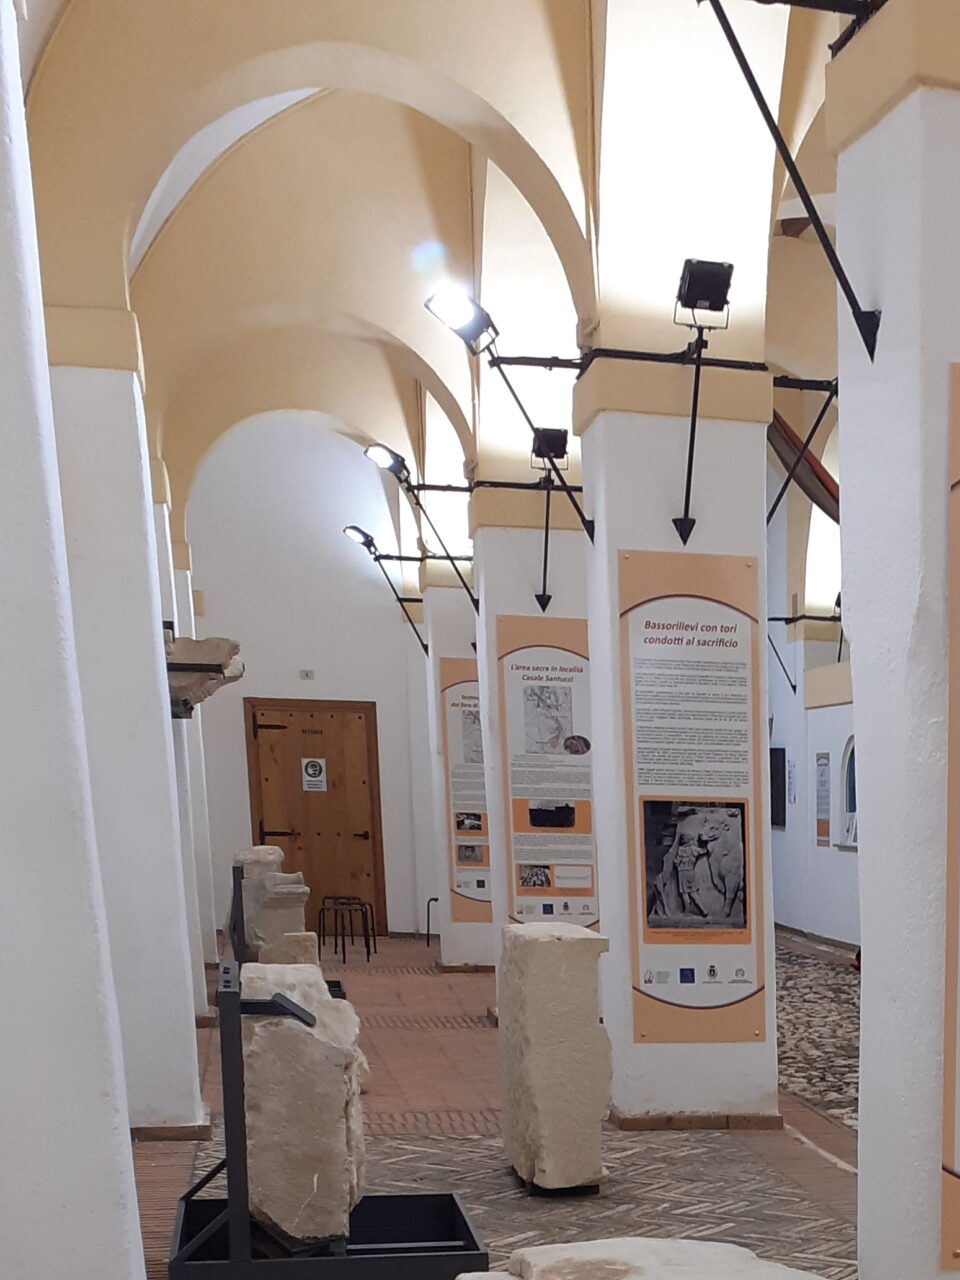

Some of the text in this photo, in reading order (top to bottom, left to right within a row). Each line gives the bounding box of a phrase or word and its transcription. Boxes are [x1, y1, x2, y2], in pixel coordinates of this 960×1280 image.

[644, 620, 738, 634] Bassorilievi con tori
[643, 635, 739, 649] condotti al sacrificio
[521, 674, 544, 682] Casale
